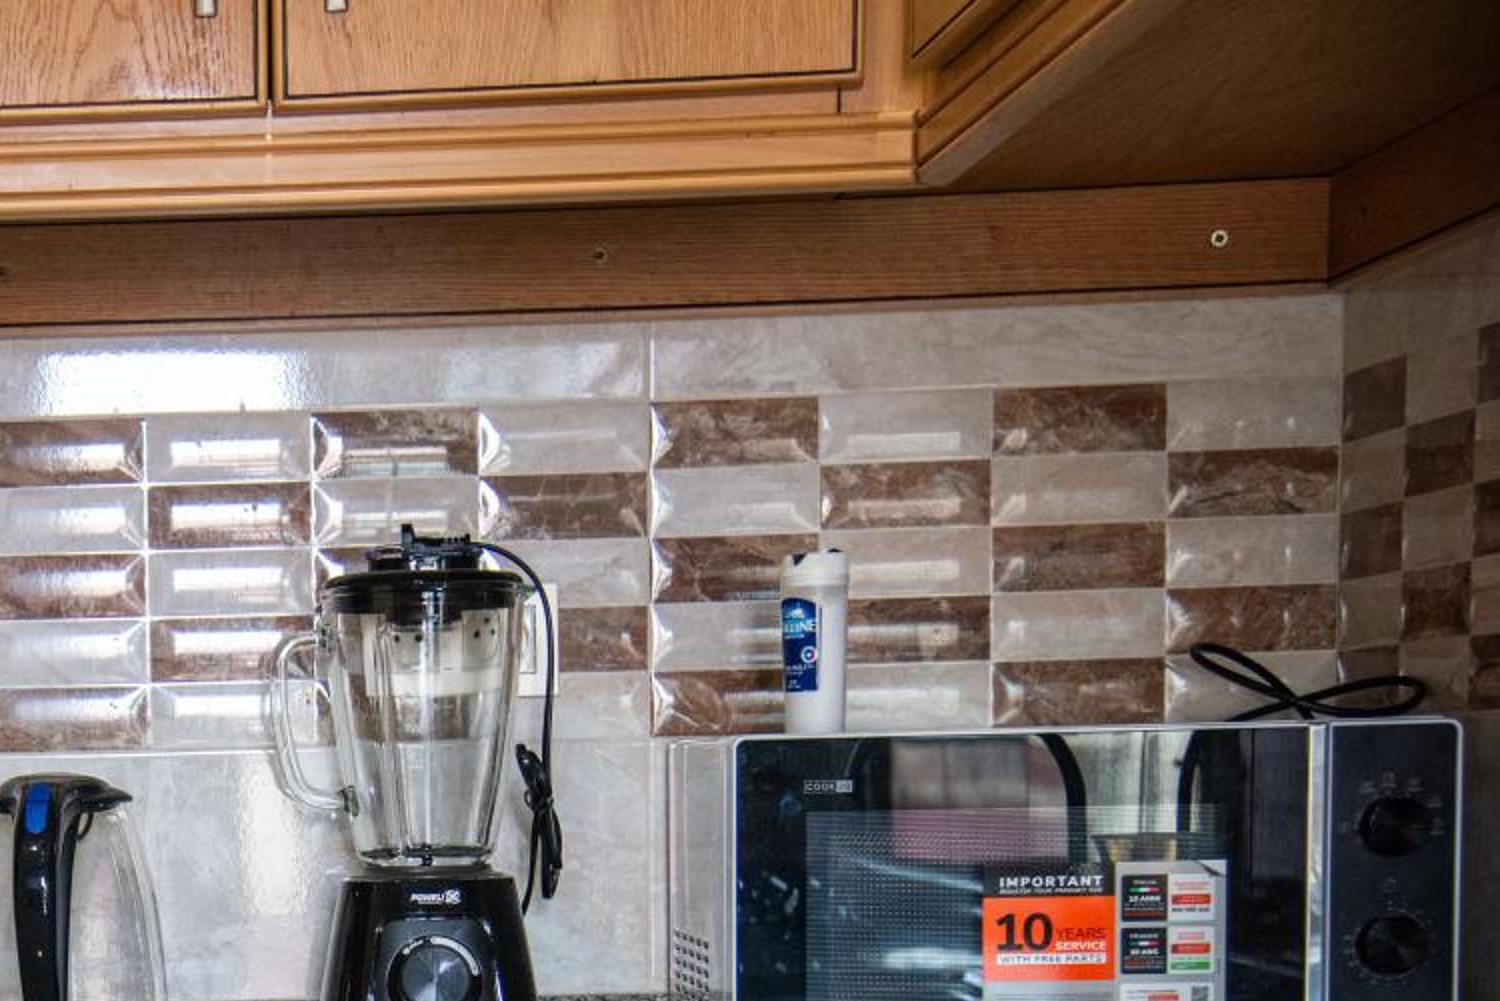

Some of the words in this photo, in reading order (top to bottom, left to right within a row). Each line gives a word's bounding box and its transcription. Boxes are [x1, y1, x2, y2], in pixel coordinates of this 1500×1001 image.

[999, 875, 1104, 888] IMPORTANT
[995, 912, 1053, 951] 10
[1056, 927, 1106, 939] YEARS
[1055, 940, 1106, 952] SERVICE
[1001, 955, 1032, 963] WITH
[1035, 955, 1061, 963] FREE
[1065, 954, 1104, 962] PARTS
